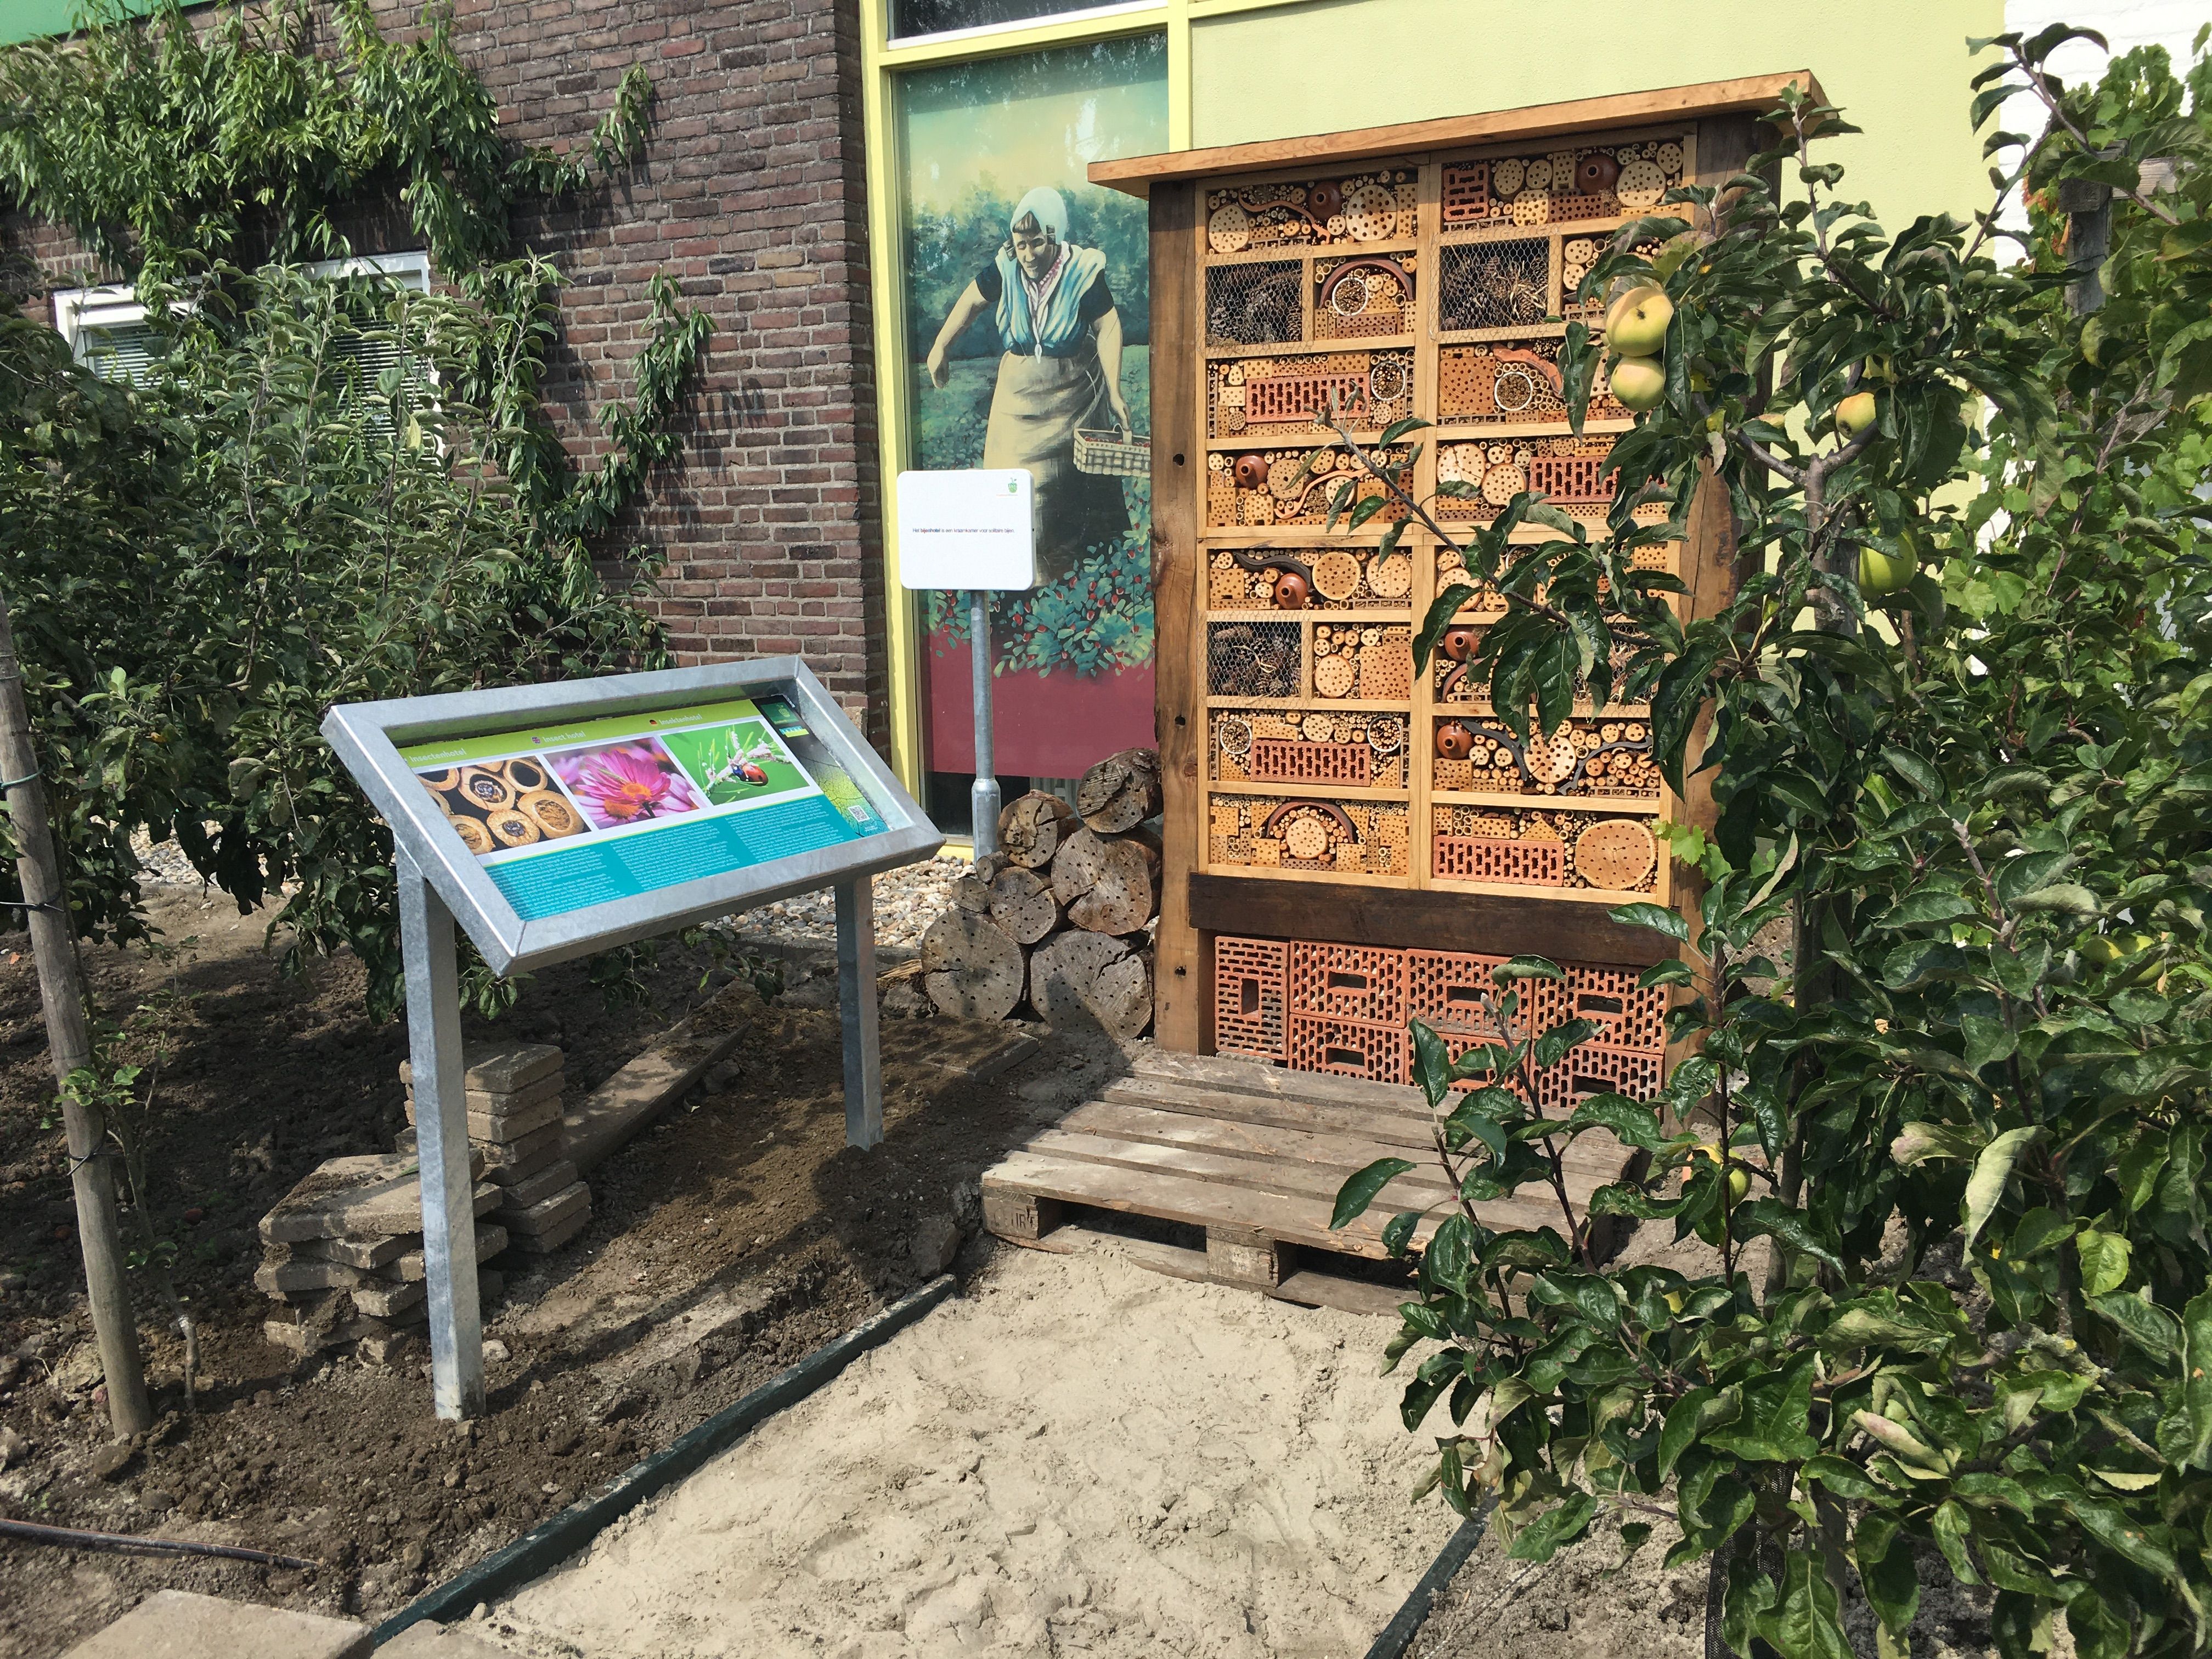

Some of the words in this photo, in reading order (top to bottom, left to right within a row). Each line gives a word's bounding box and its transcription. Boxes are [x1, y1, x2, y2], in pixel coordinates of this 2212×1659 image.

[541, 734, 567, 742] Insect
[565, 730, 586, 739] hotel
[409, 748, 467, 763] Insectenhotel
